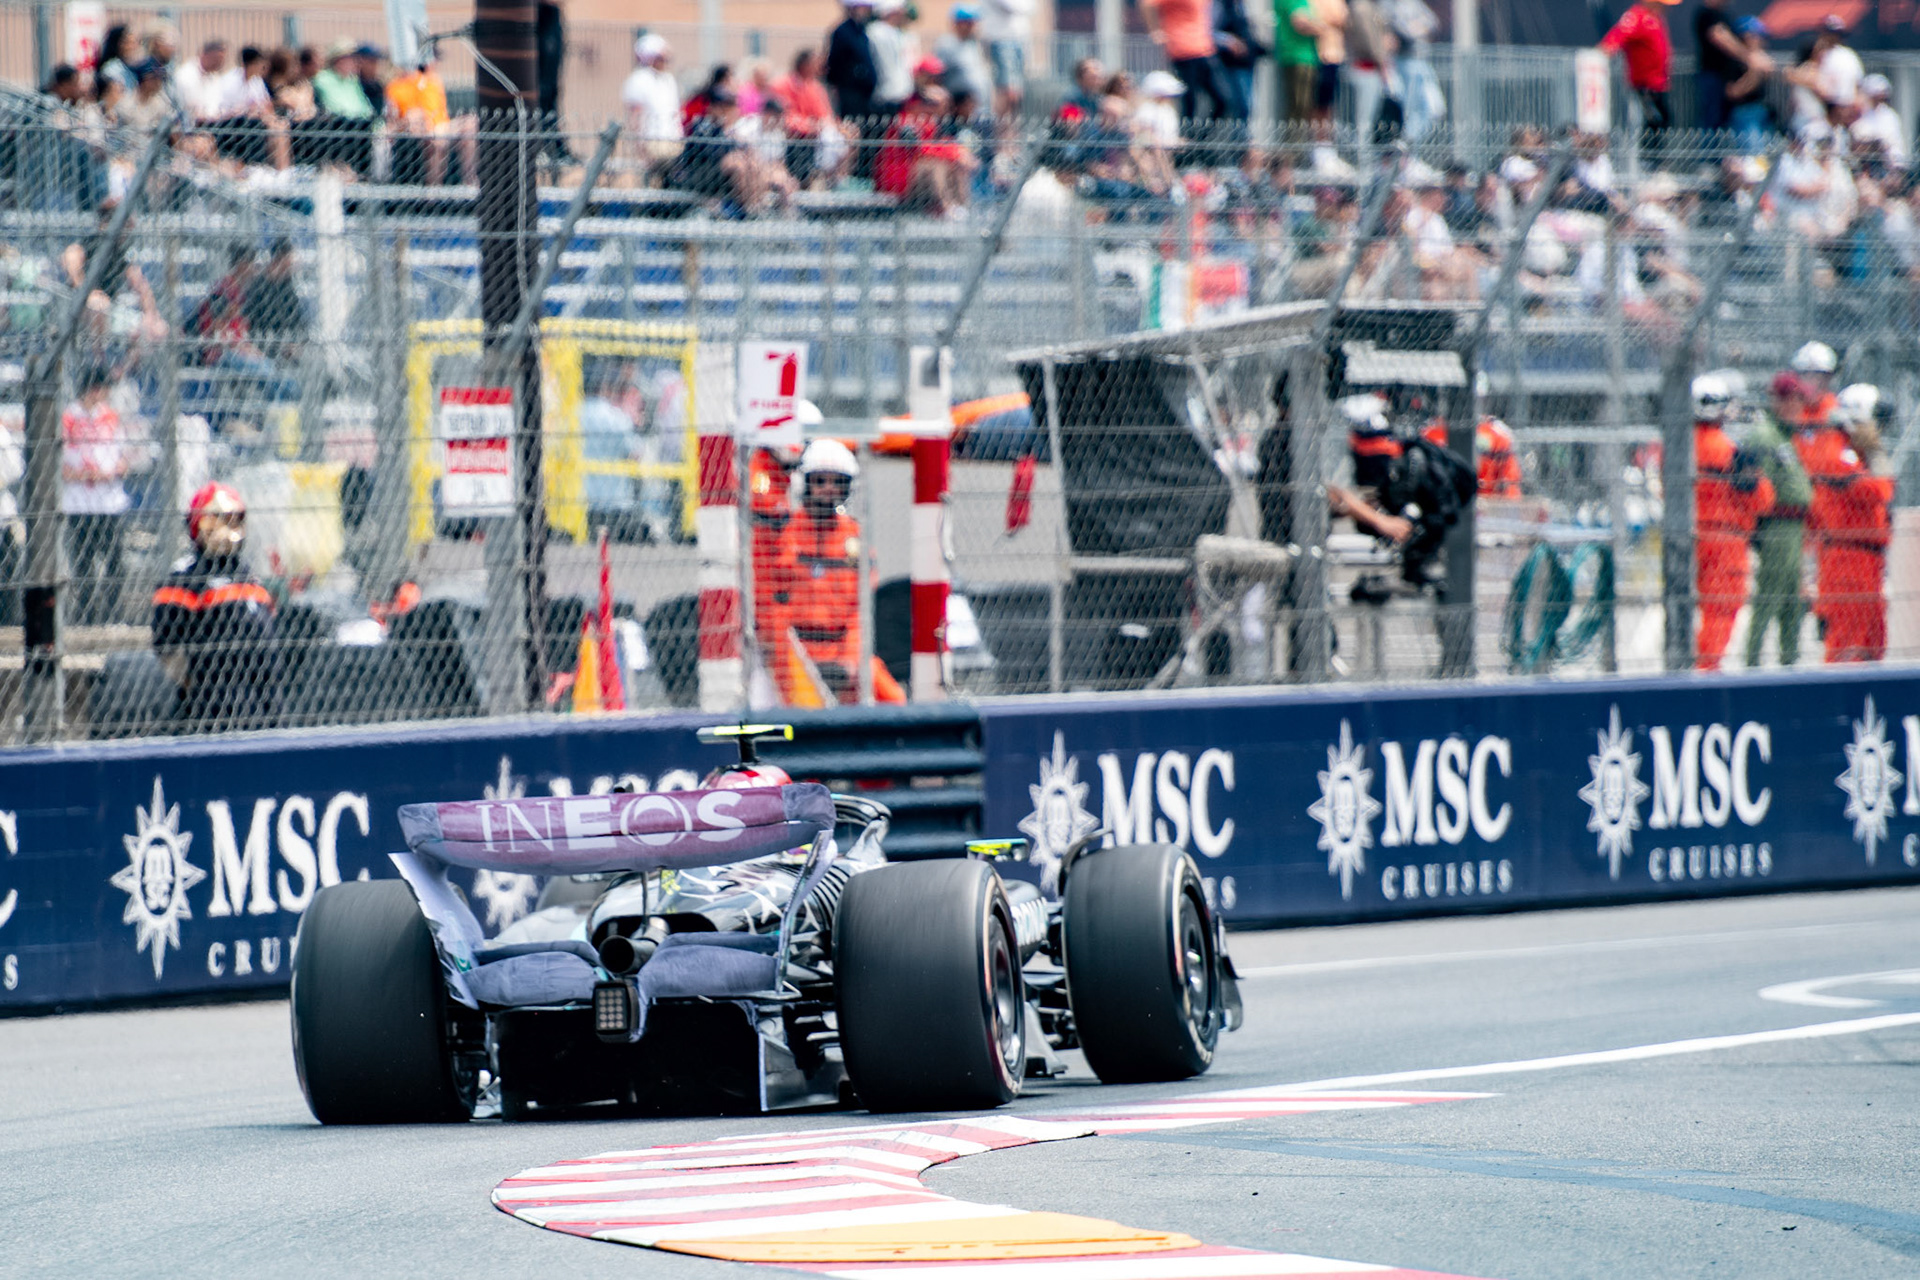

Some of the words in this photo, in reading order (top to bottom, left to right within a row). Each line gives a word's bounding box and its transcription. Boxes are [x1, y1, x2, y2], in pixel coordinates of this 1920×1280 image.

[475, 790, 747, 853] INEOS
[1097, 747, 1236, 858] MSC
[1380, 735, 1513, 847] MSC
[1648, 721, 1772, 830] MSC
[206, 791, 370, 917] MSC
[1381, 859, 1514, 901] CRUISES
[1648, 842, 1773, 883] CRUISES
